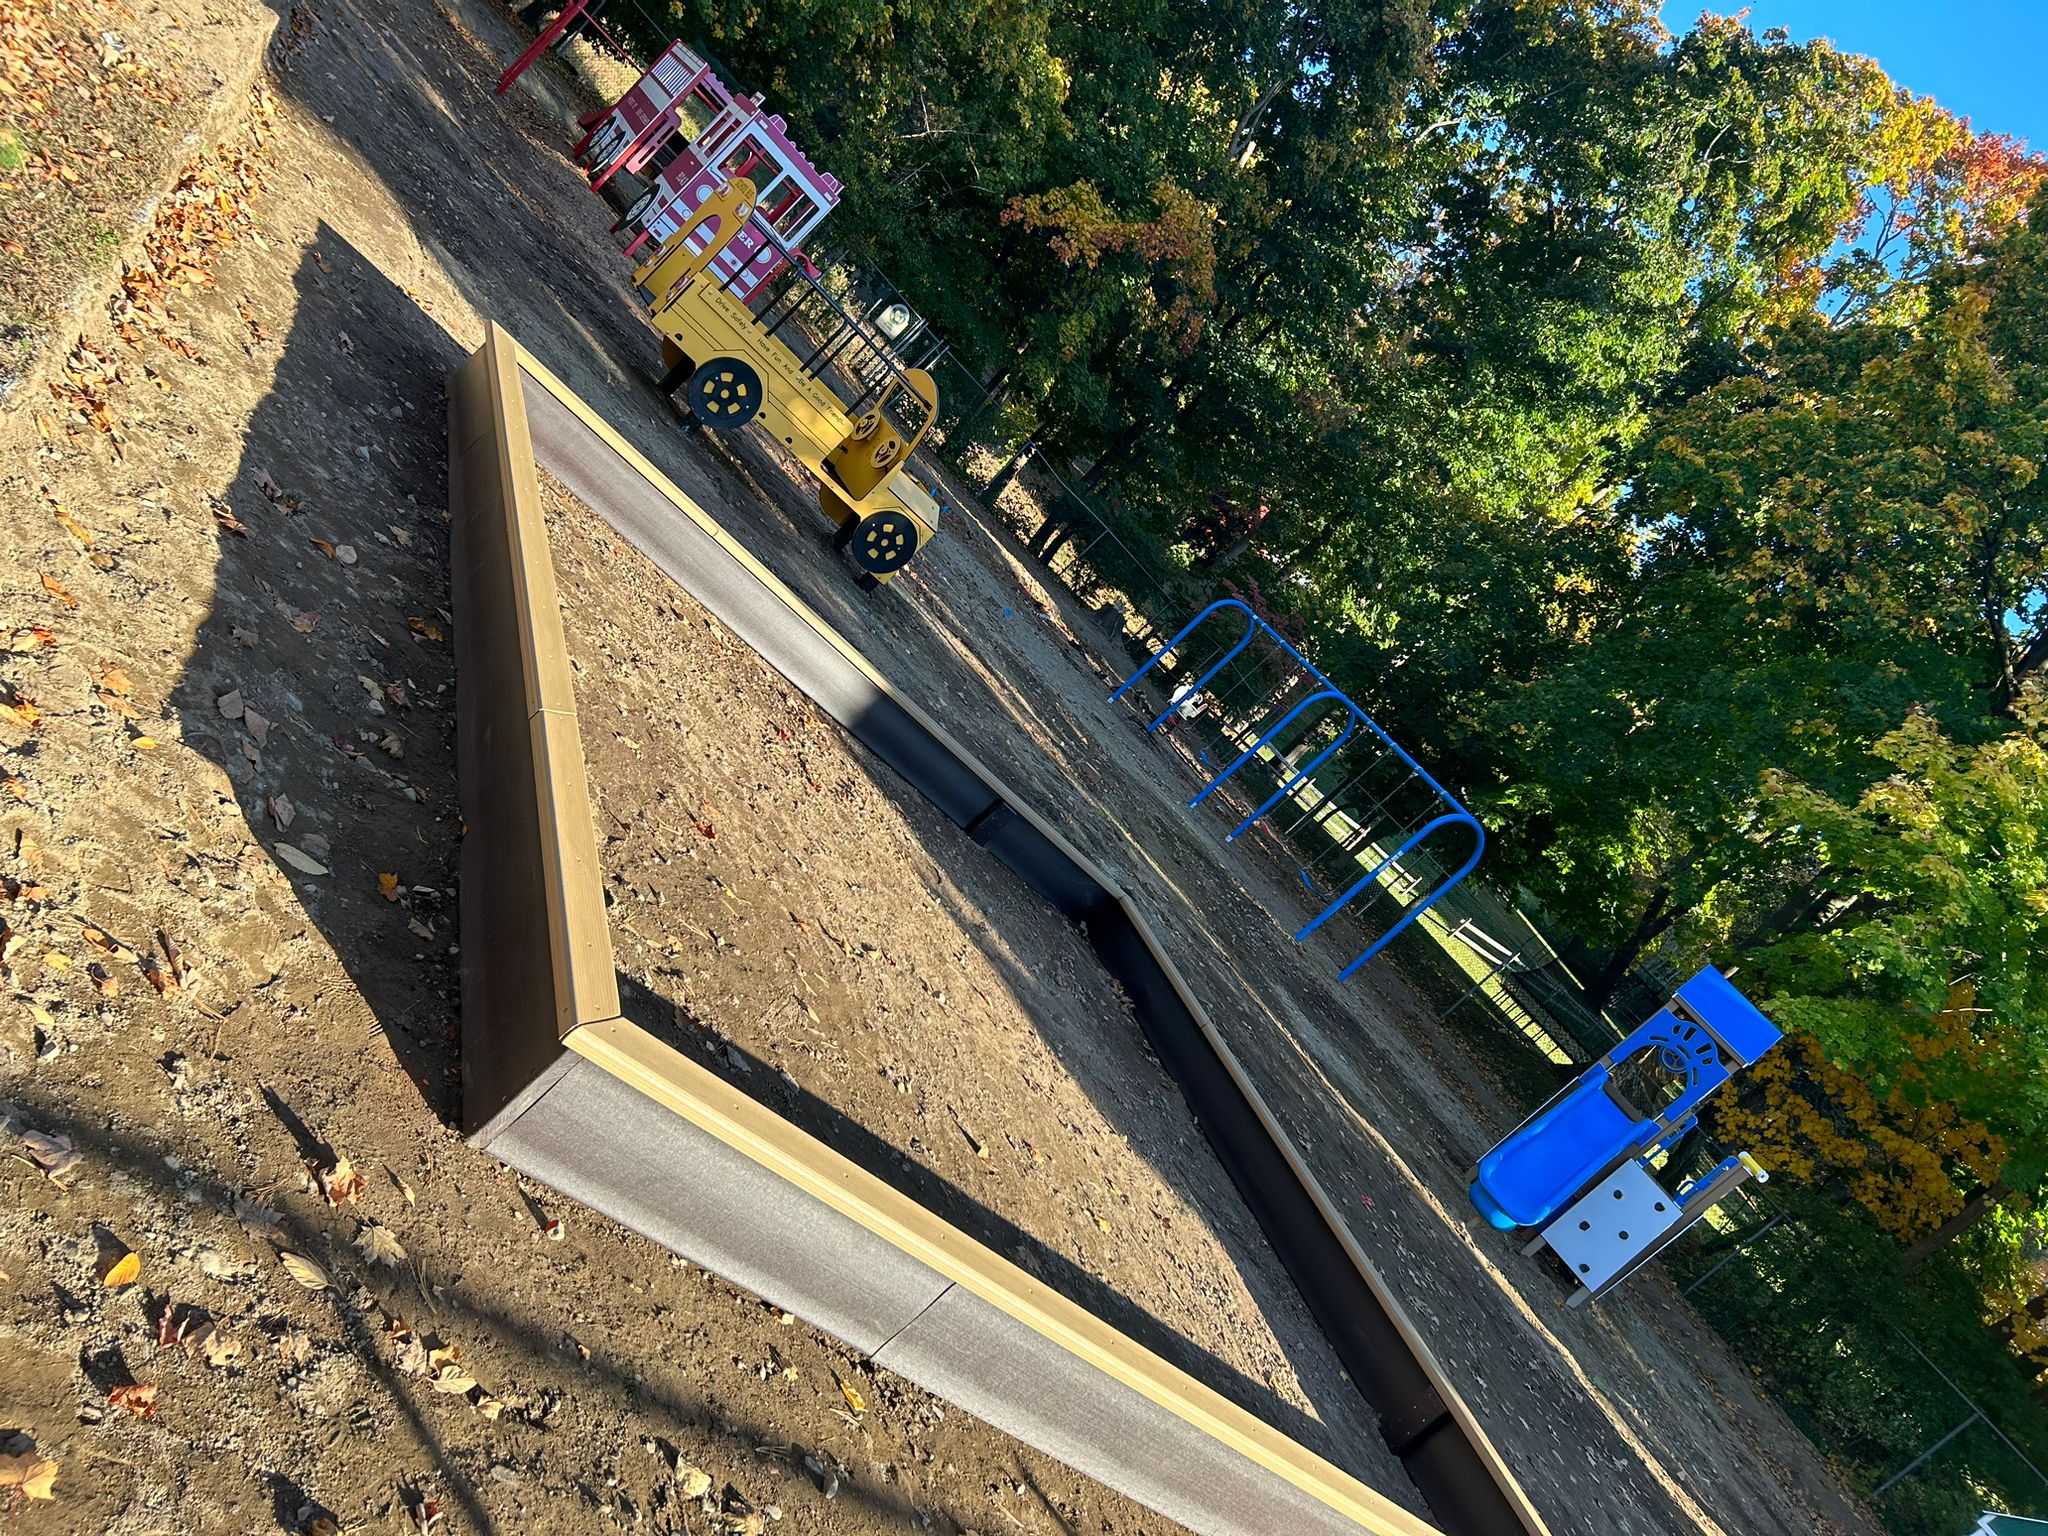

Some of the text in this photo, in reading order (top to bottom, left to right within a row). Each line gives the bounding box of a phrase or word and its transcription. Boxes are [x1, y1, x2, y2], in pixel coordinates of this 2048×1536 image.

[715, 297, 748, 330] Drive Safely
[757, 338, 794, 375] Have Fun And
[798, 378, 806, 387] Be
[812, 392, 826, 407] Good
